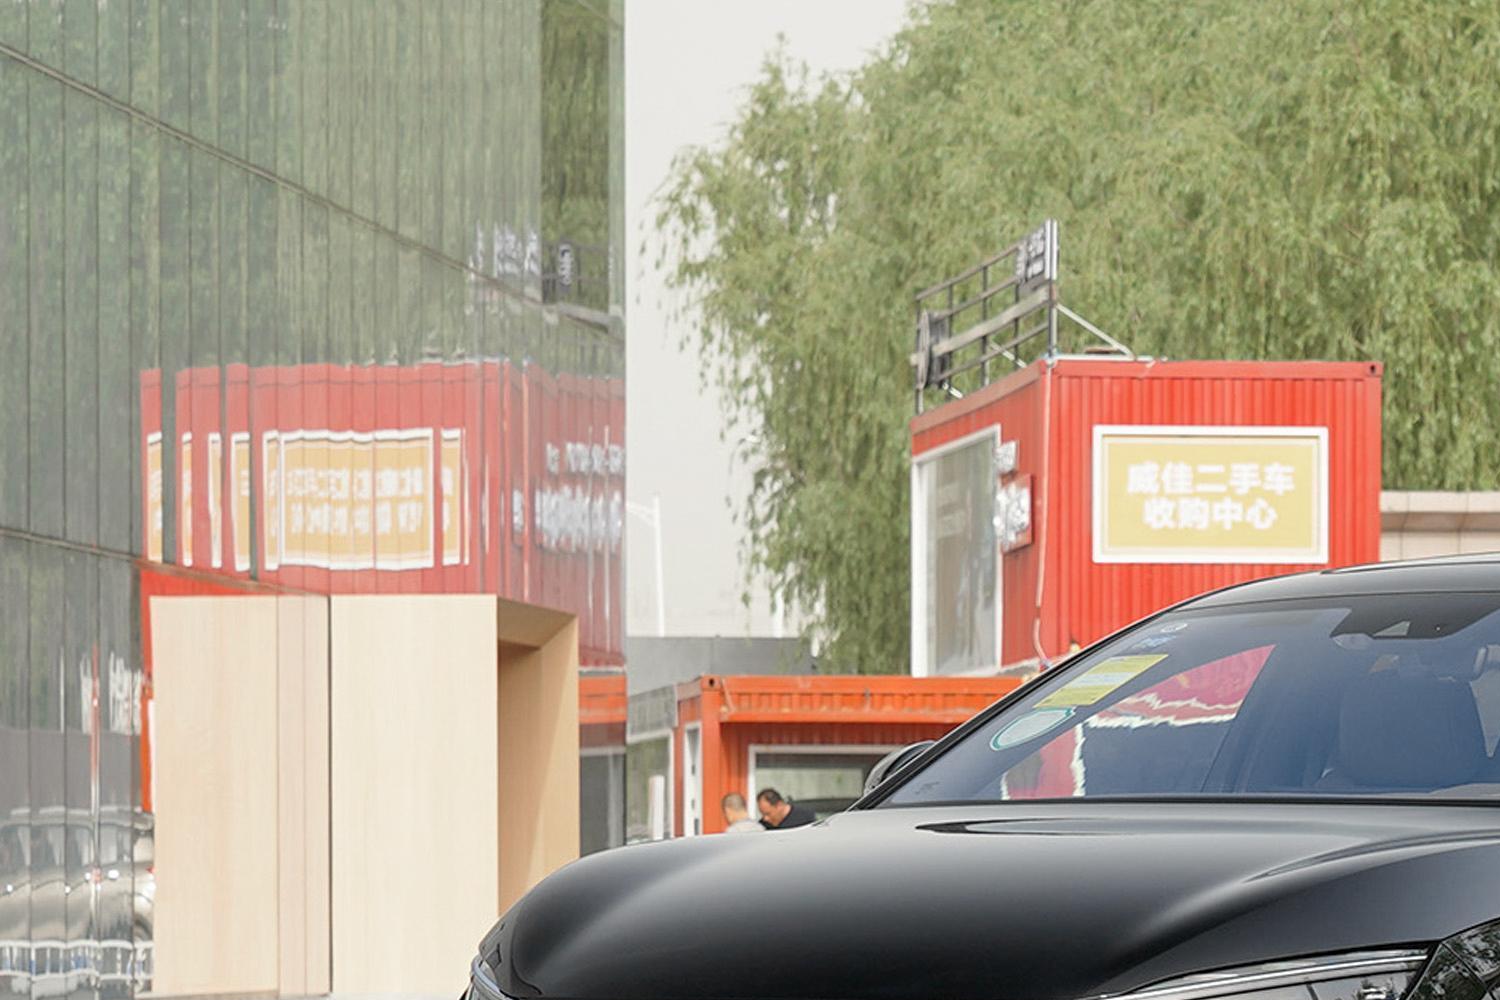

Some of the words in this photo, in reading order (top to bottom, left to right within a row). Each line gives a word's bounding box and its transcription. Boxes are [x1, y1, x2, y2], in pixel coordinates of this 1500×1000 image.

[1127, 460, 1296, 496] 威佳二手车
[1142, 496, 1278, 531] 收购中心
